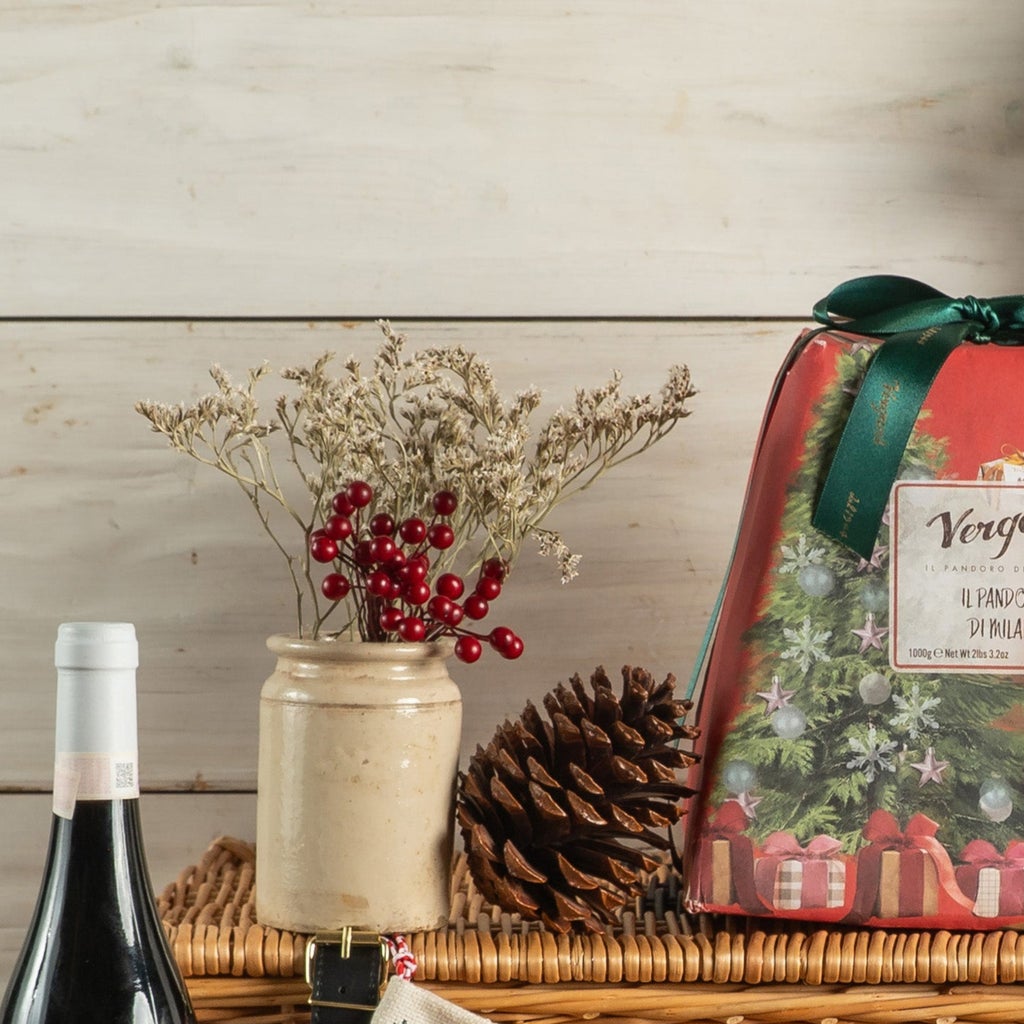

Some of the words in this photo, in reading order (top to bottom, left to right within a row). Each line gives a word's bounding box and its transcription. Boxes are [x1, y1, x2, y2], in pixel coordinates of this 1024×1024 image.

[944, 564, 1005, 573] PANDORO
[962, 587, 972, 608] IL
[966, 617, 984, 639] DI
[908, 648, 932, 660] 1000g
[944, 648, 959, 658] Net
[960, 649, 971, 658] Wt
[972, 649, 988, 659] 2lbs
[988, 650, 1008, 660] 3.2oz
